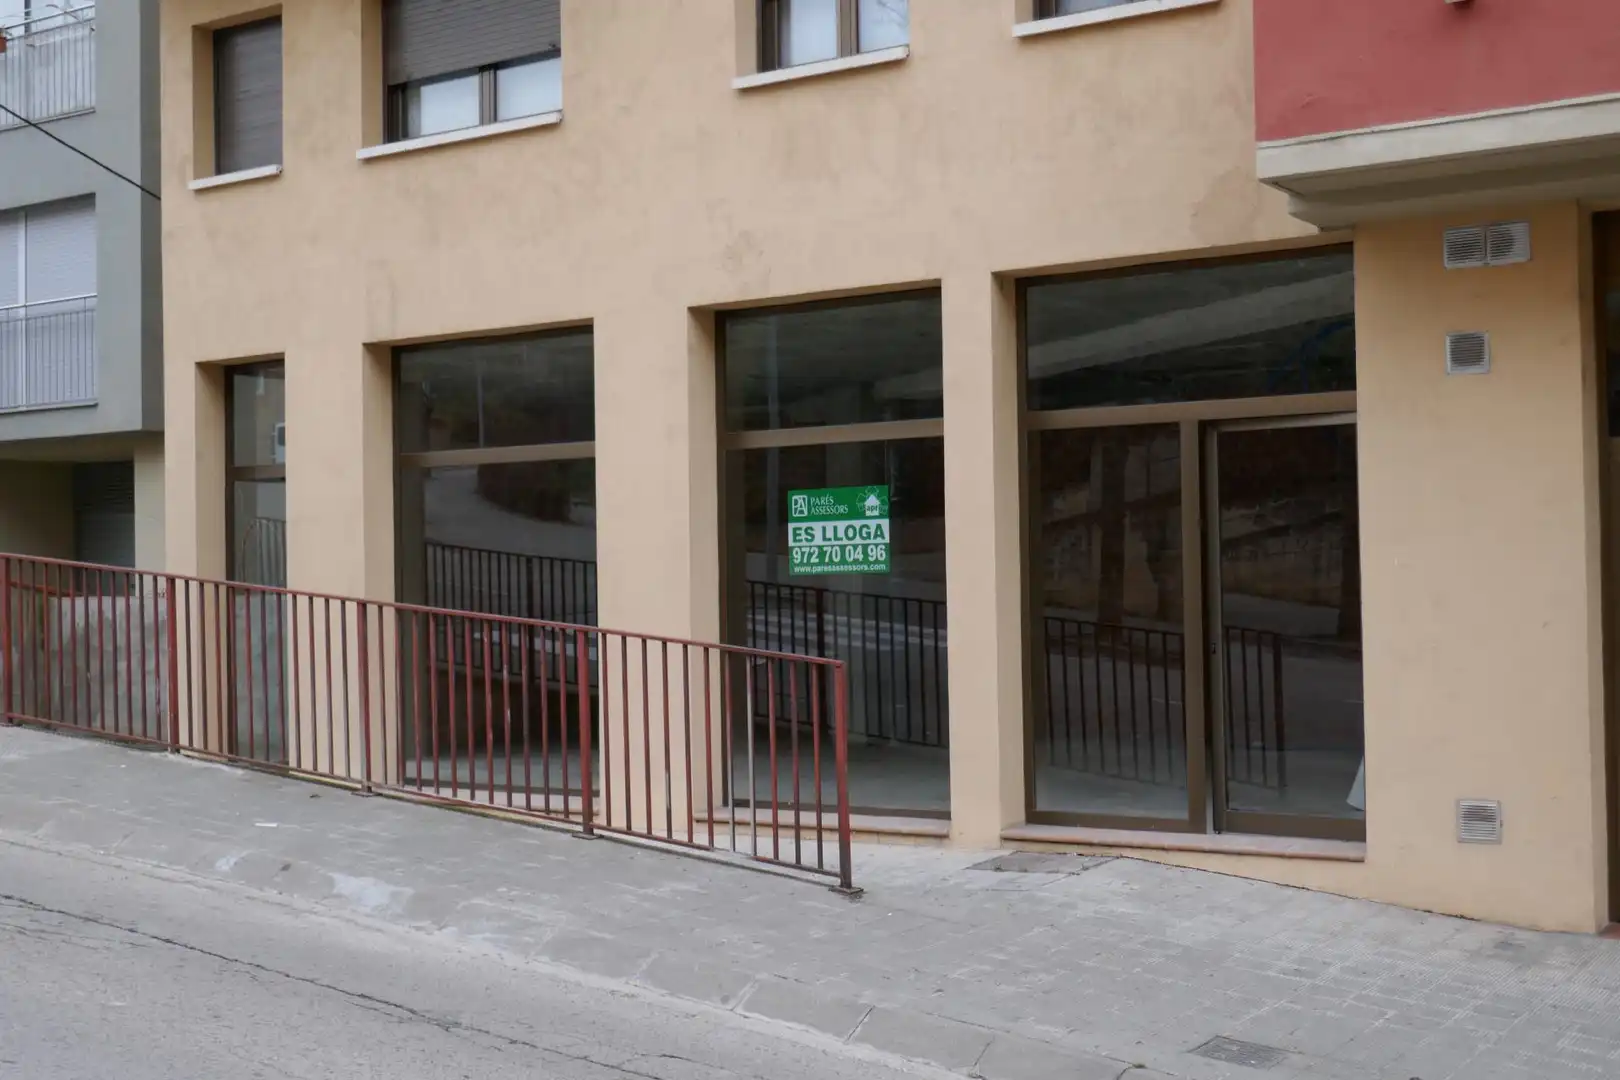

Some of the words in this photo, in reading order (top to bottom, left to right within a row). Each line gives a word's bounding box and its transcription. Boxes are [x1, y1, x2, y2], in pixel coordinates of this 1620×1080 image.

[811, 493, 834, 506] PARÉS
[811, 504, 848, 515] ASSESSORS
[792, 526, 815, 543] ES
[822, 523, 885, 541] LLOGA
[793, 547, 819, 563] 972
[823, 546, 840, 562] 70
[845, 545, 863, 562] 04
[868, 544, 886, 561] 96
[794, 563, 886, 574] www.paresassessors.com
